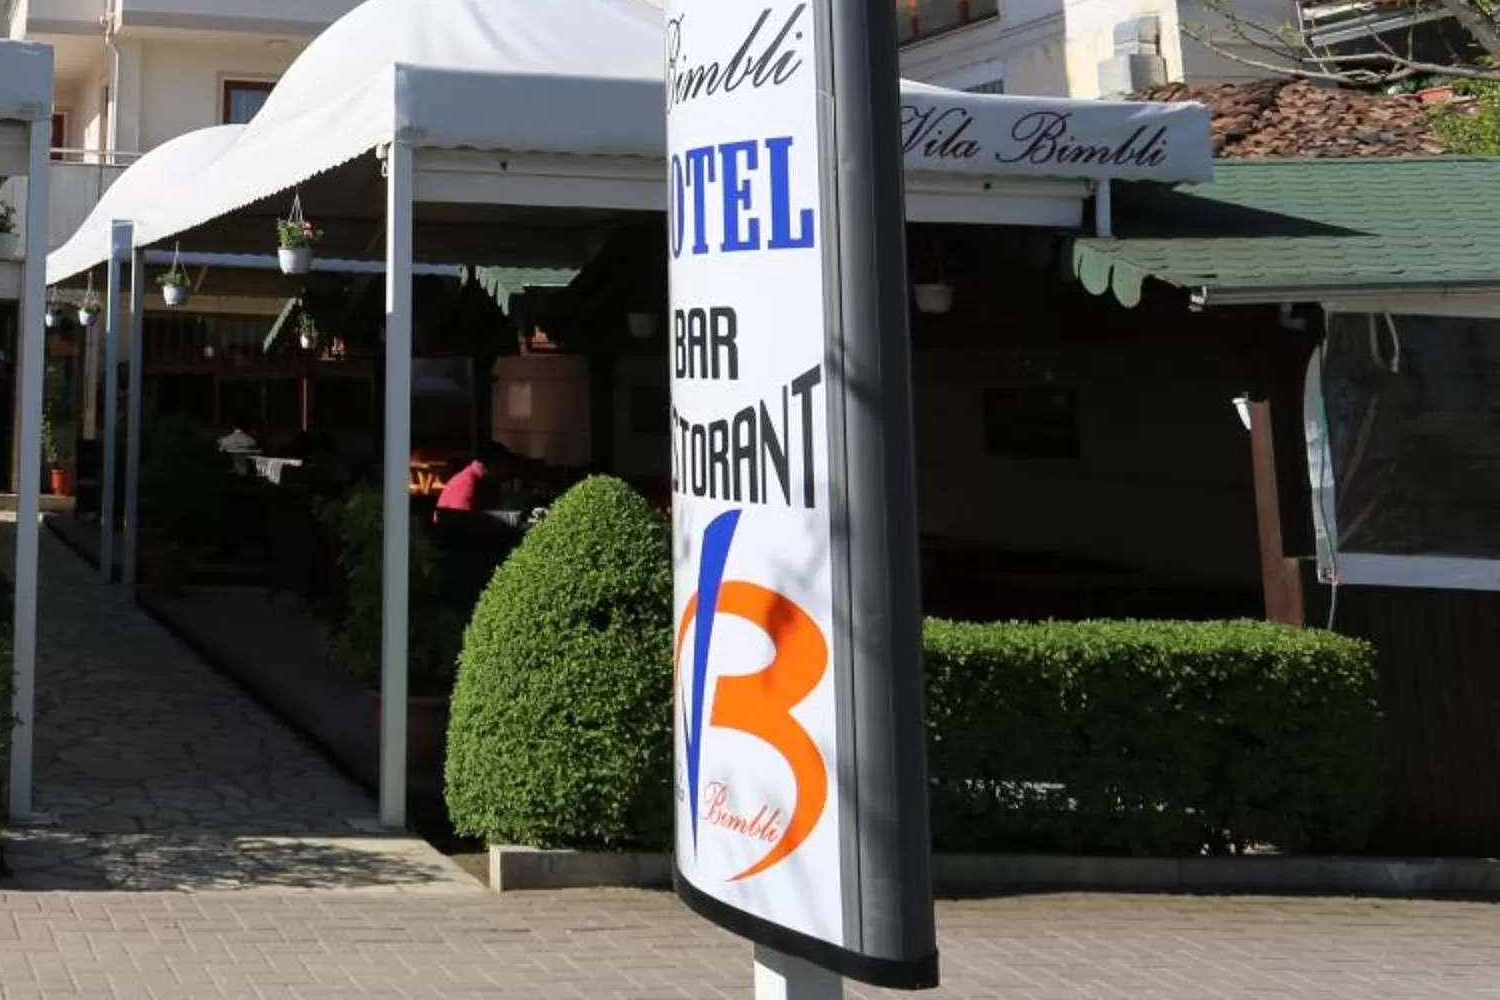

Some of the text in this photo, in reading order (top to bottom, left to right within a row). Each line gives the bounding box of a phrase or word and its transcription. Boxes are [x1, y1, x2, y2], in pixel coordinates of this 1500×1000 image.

[666, 2, 807, 116] Bimbli
[900, 105, 1169, 167] Vila Bimbli
[670, 136, 815, 260] OTEL
[674, 305, 739, 381] BAR
[672, 363, 822, 509] STORANT
[700, 781, 783, 844] Bimbli
